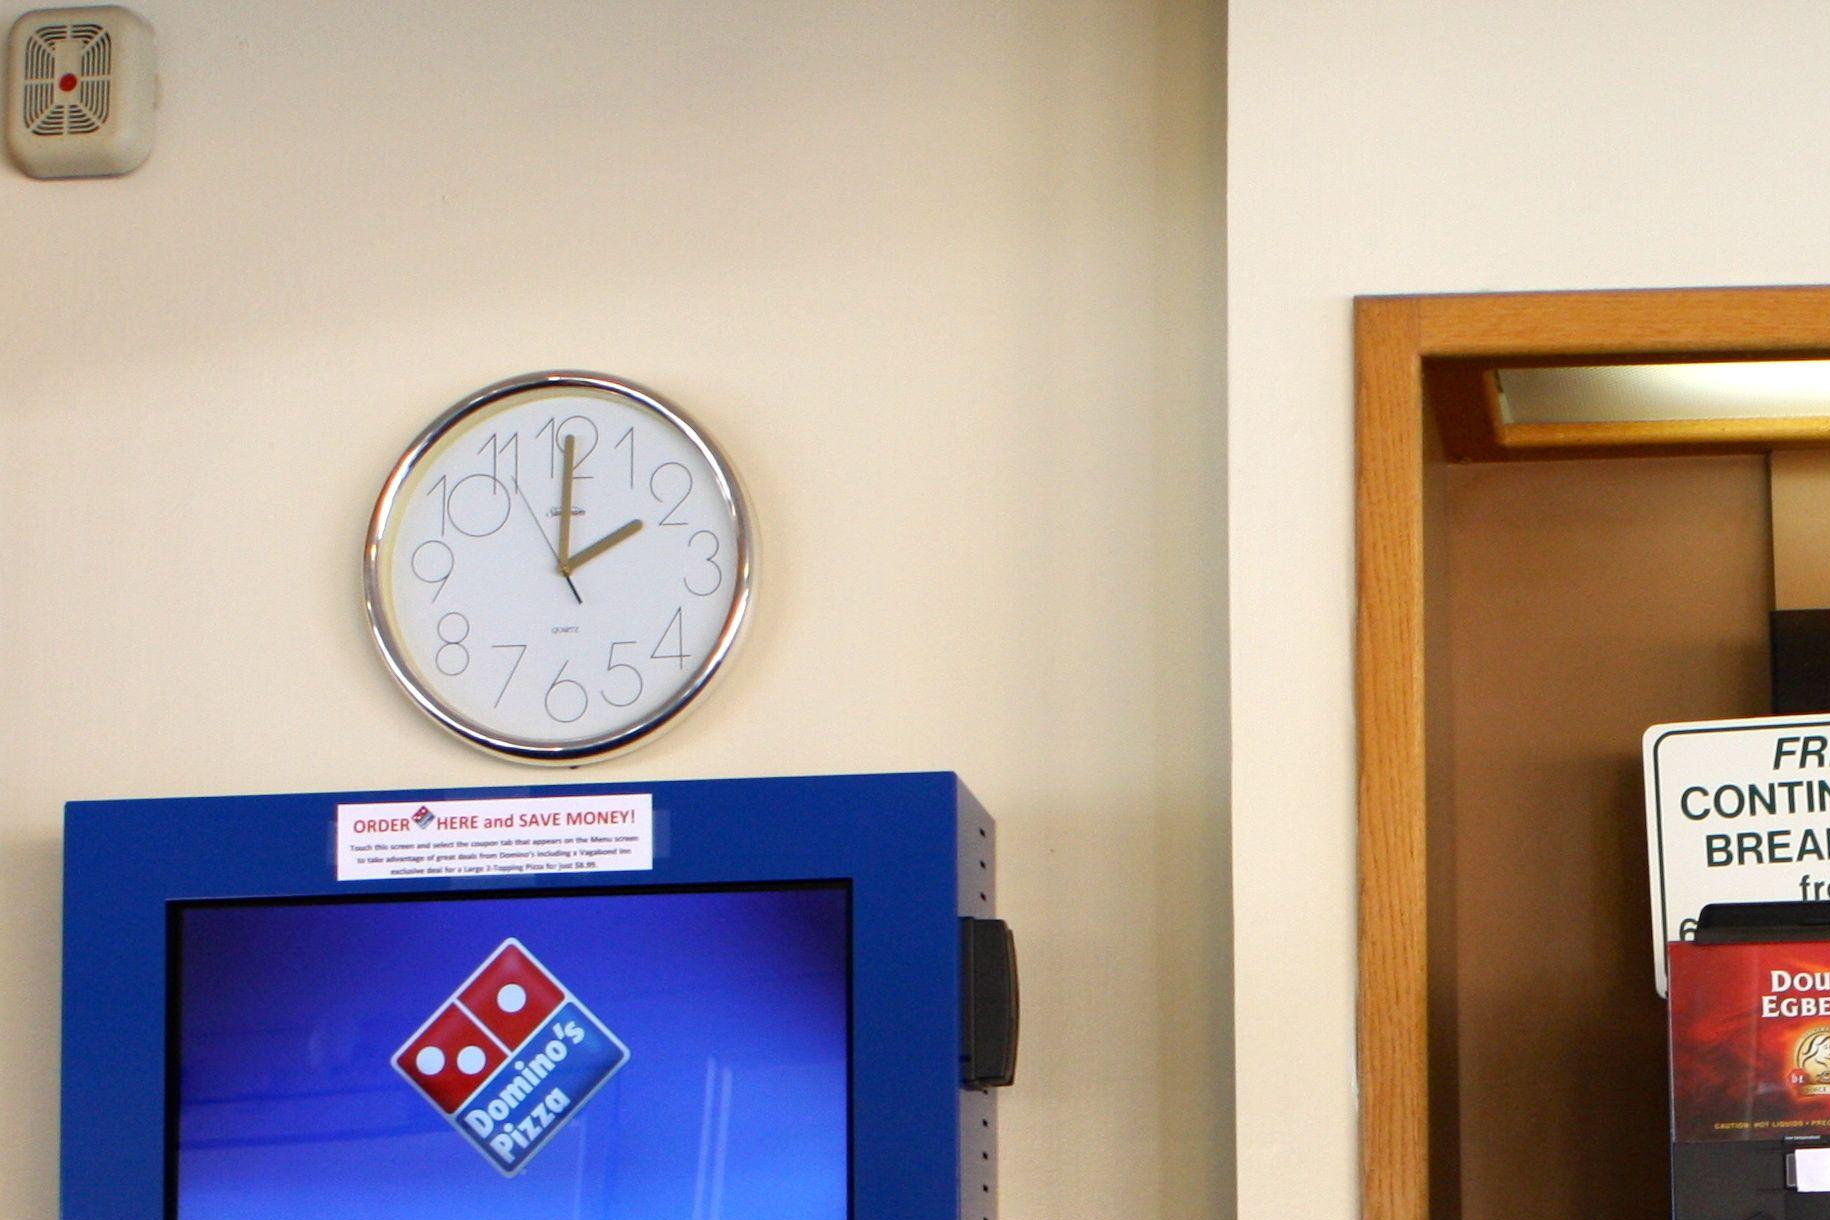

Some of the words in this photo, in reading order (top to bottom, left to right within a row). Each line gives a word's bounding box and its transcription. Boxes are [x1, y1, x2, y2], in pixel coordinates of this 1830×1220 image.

[478, 432, 519, 495] 11
[535, 416, 599, 479] 12
[615, 426, 634, 489] 1
[427, 474, 511, 537] 10
[649, 462, 693, 527] 2
[411, 540, 454, 603] 9
[684, 530, 722, 596] 3
[435, 612, 470, 676] 8
[650, 606, 691, 670] 4
[491, 644, 527, 709] 7
[545, 660, 588, 723] 6
[601, 641, 643, 707] 5
[353, 819, 410, 834] ORDER
[437, 816, 478, 830] HERE
[484, 816, 514, 829] and
[519, 813, 561, 826] SAVE
[566, 810, 635, 825] MONEY!
[464, 1020, 585, 1138] Domino's
[489, 1087, 571, 1163] Pizza
